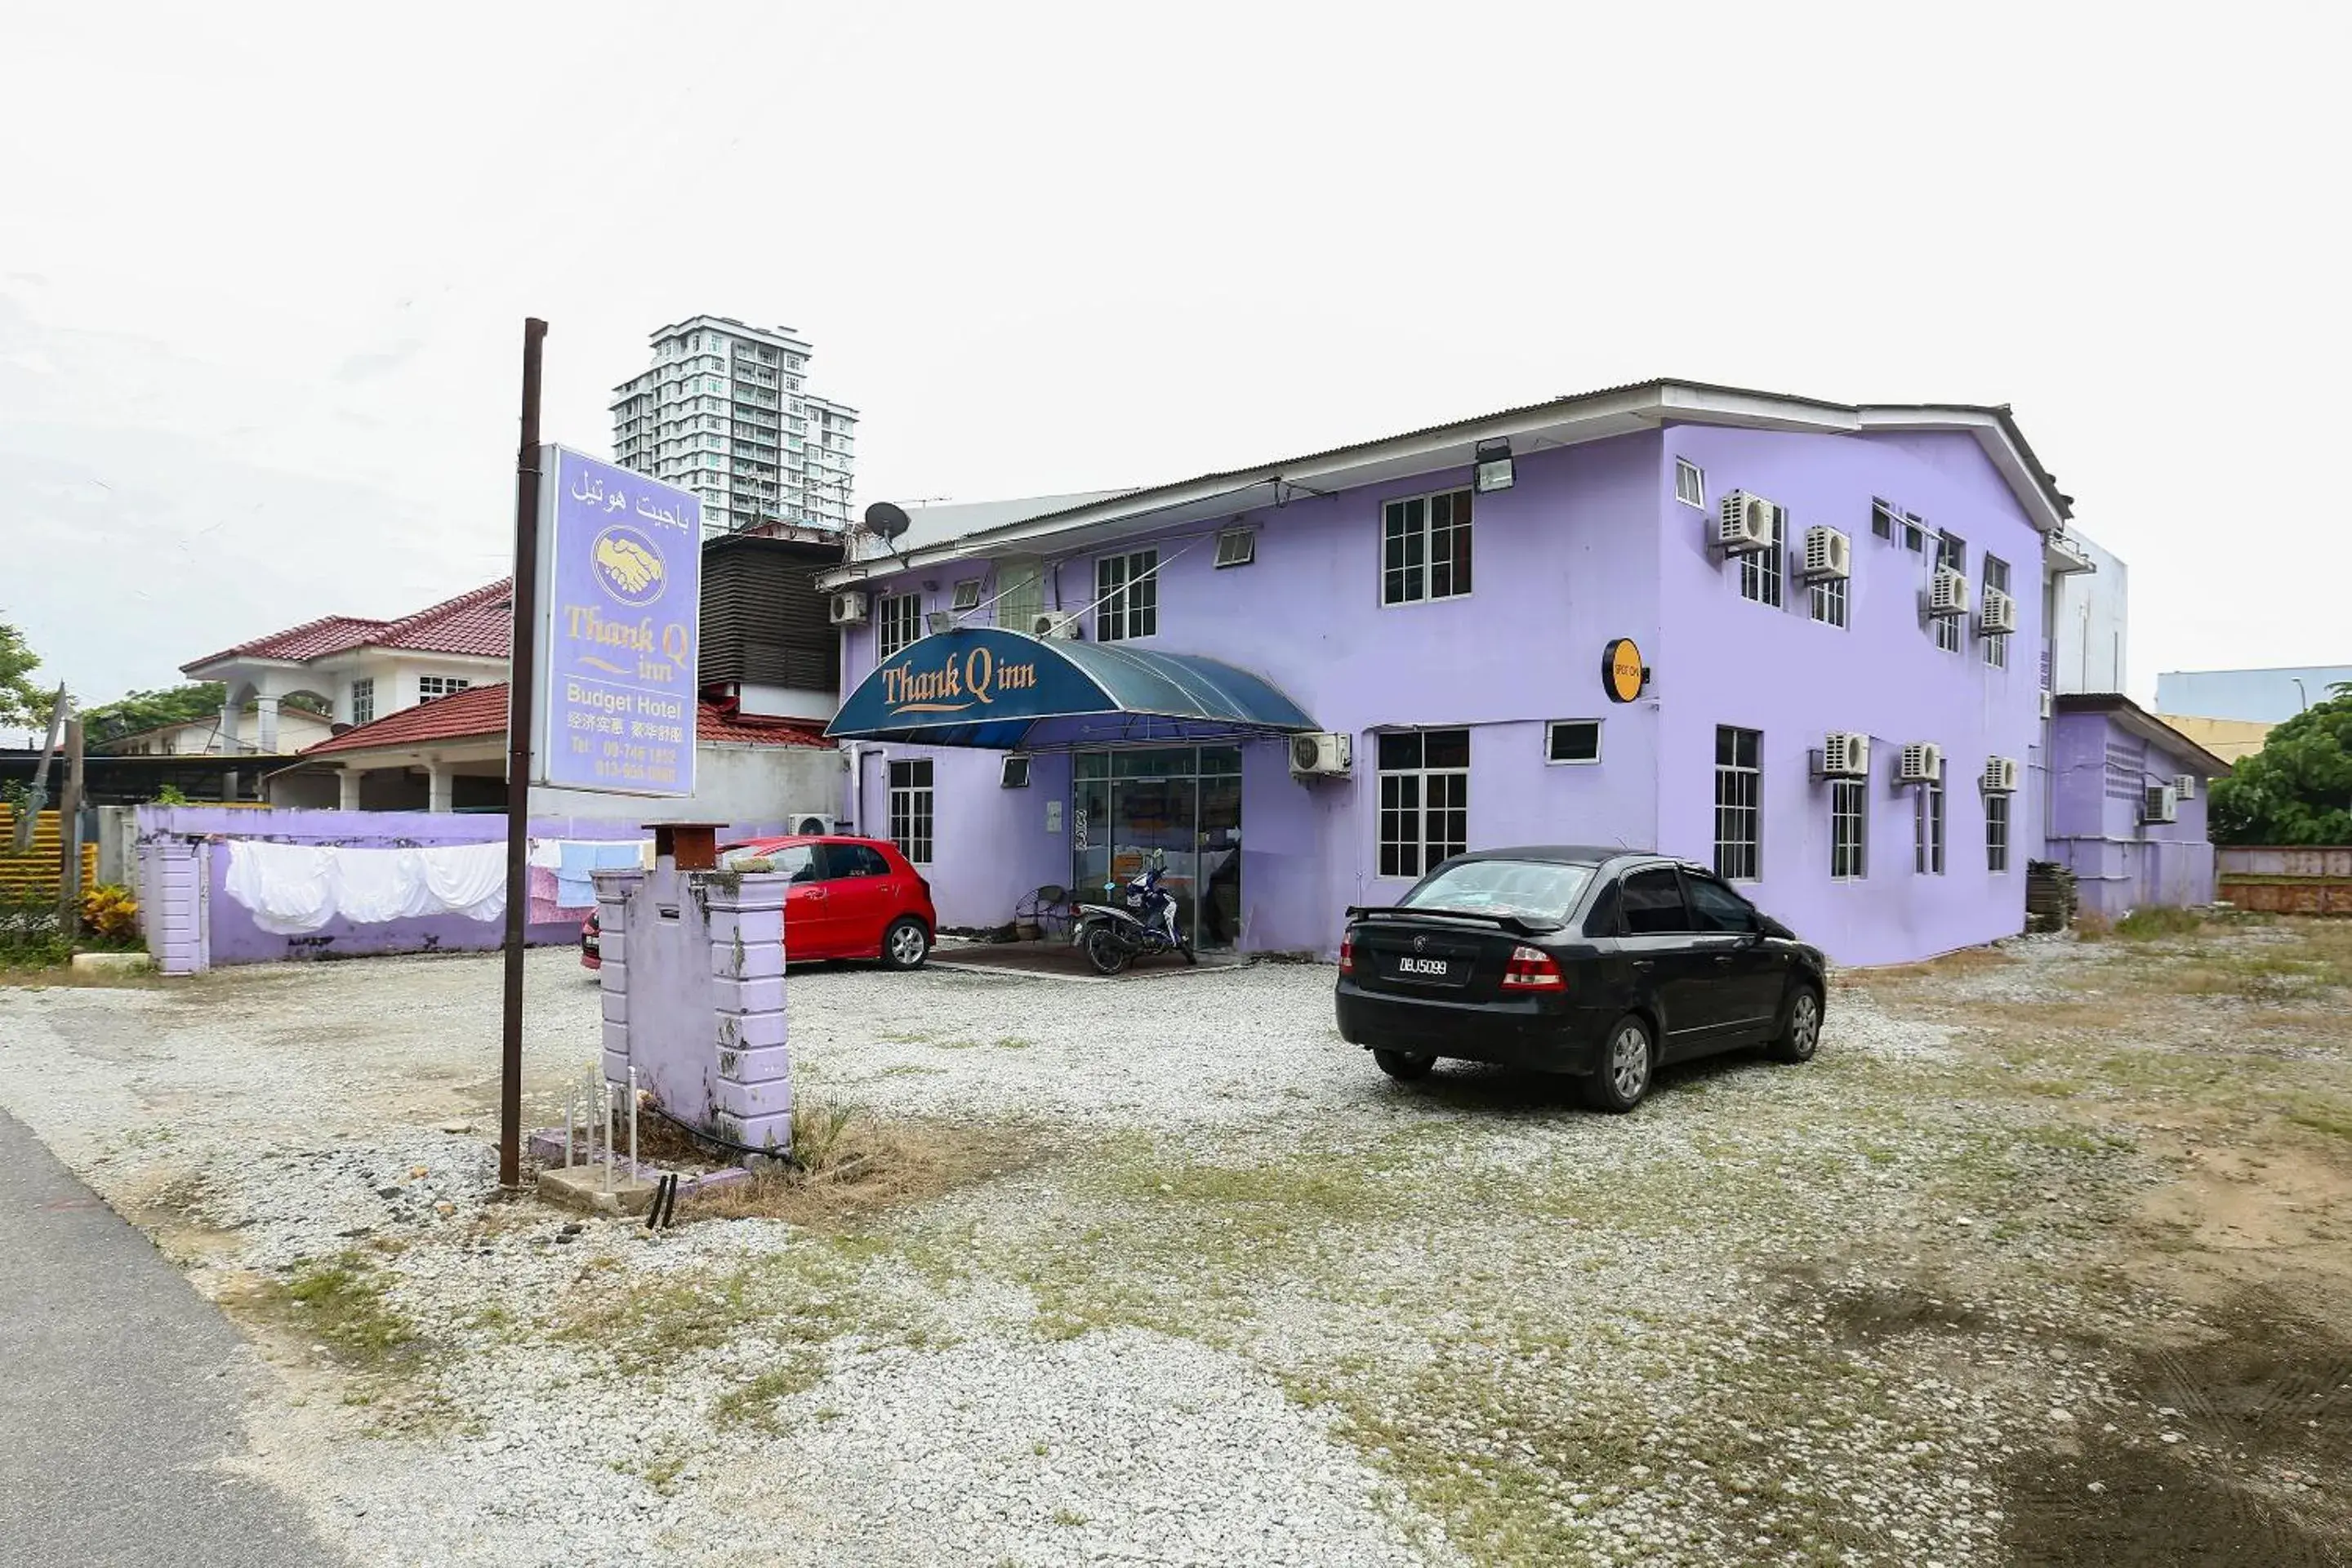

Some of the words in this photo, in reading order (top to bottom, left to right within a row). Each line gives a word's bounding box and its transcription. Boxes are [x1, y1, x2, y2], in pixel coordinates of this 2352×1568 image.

[564, 604, 655, 653] Thank
[662, 622, 689, 670] Q
[638, 654, 673, 683] inn
[882, 652, 962, 705] Thank
[964, 646, 994, 704] Q
[997, 657, 1038, 690] inn
[567, 682, 631, 715] Budget
[637, 694, 683, 720] Hotel
